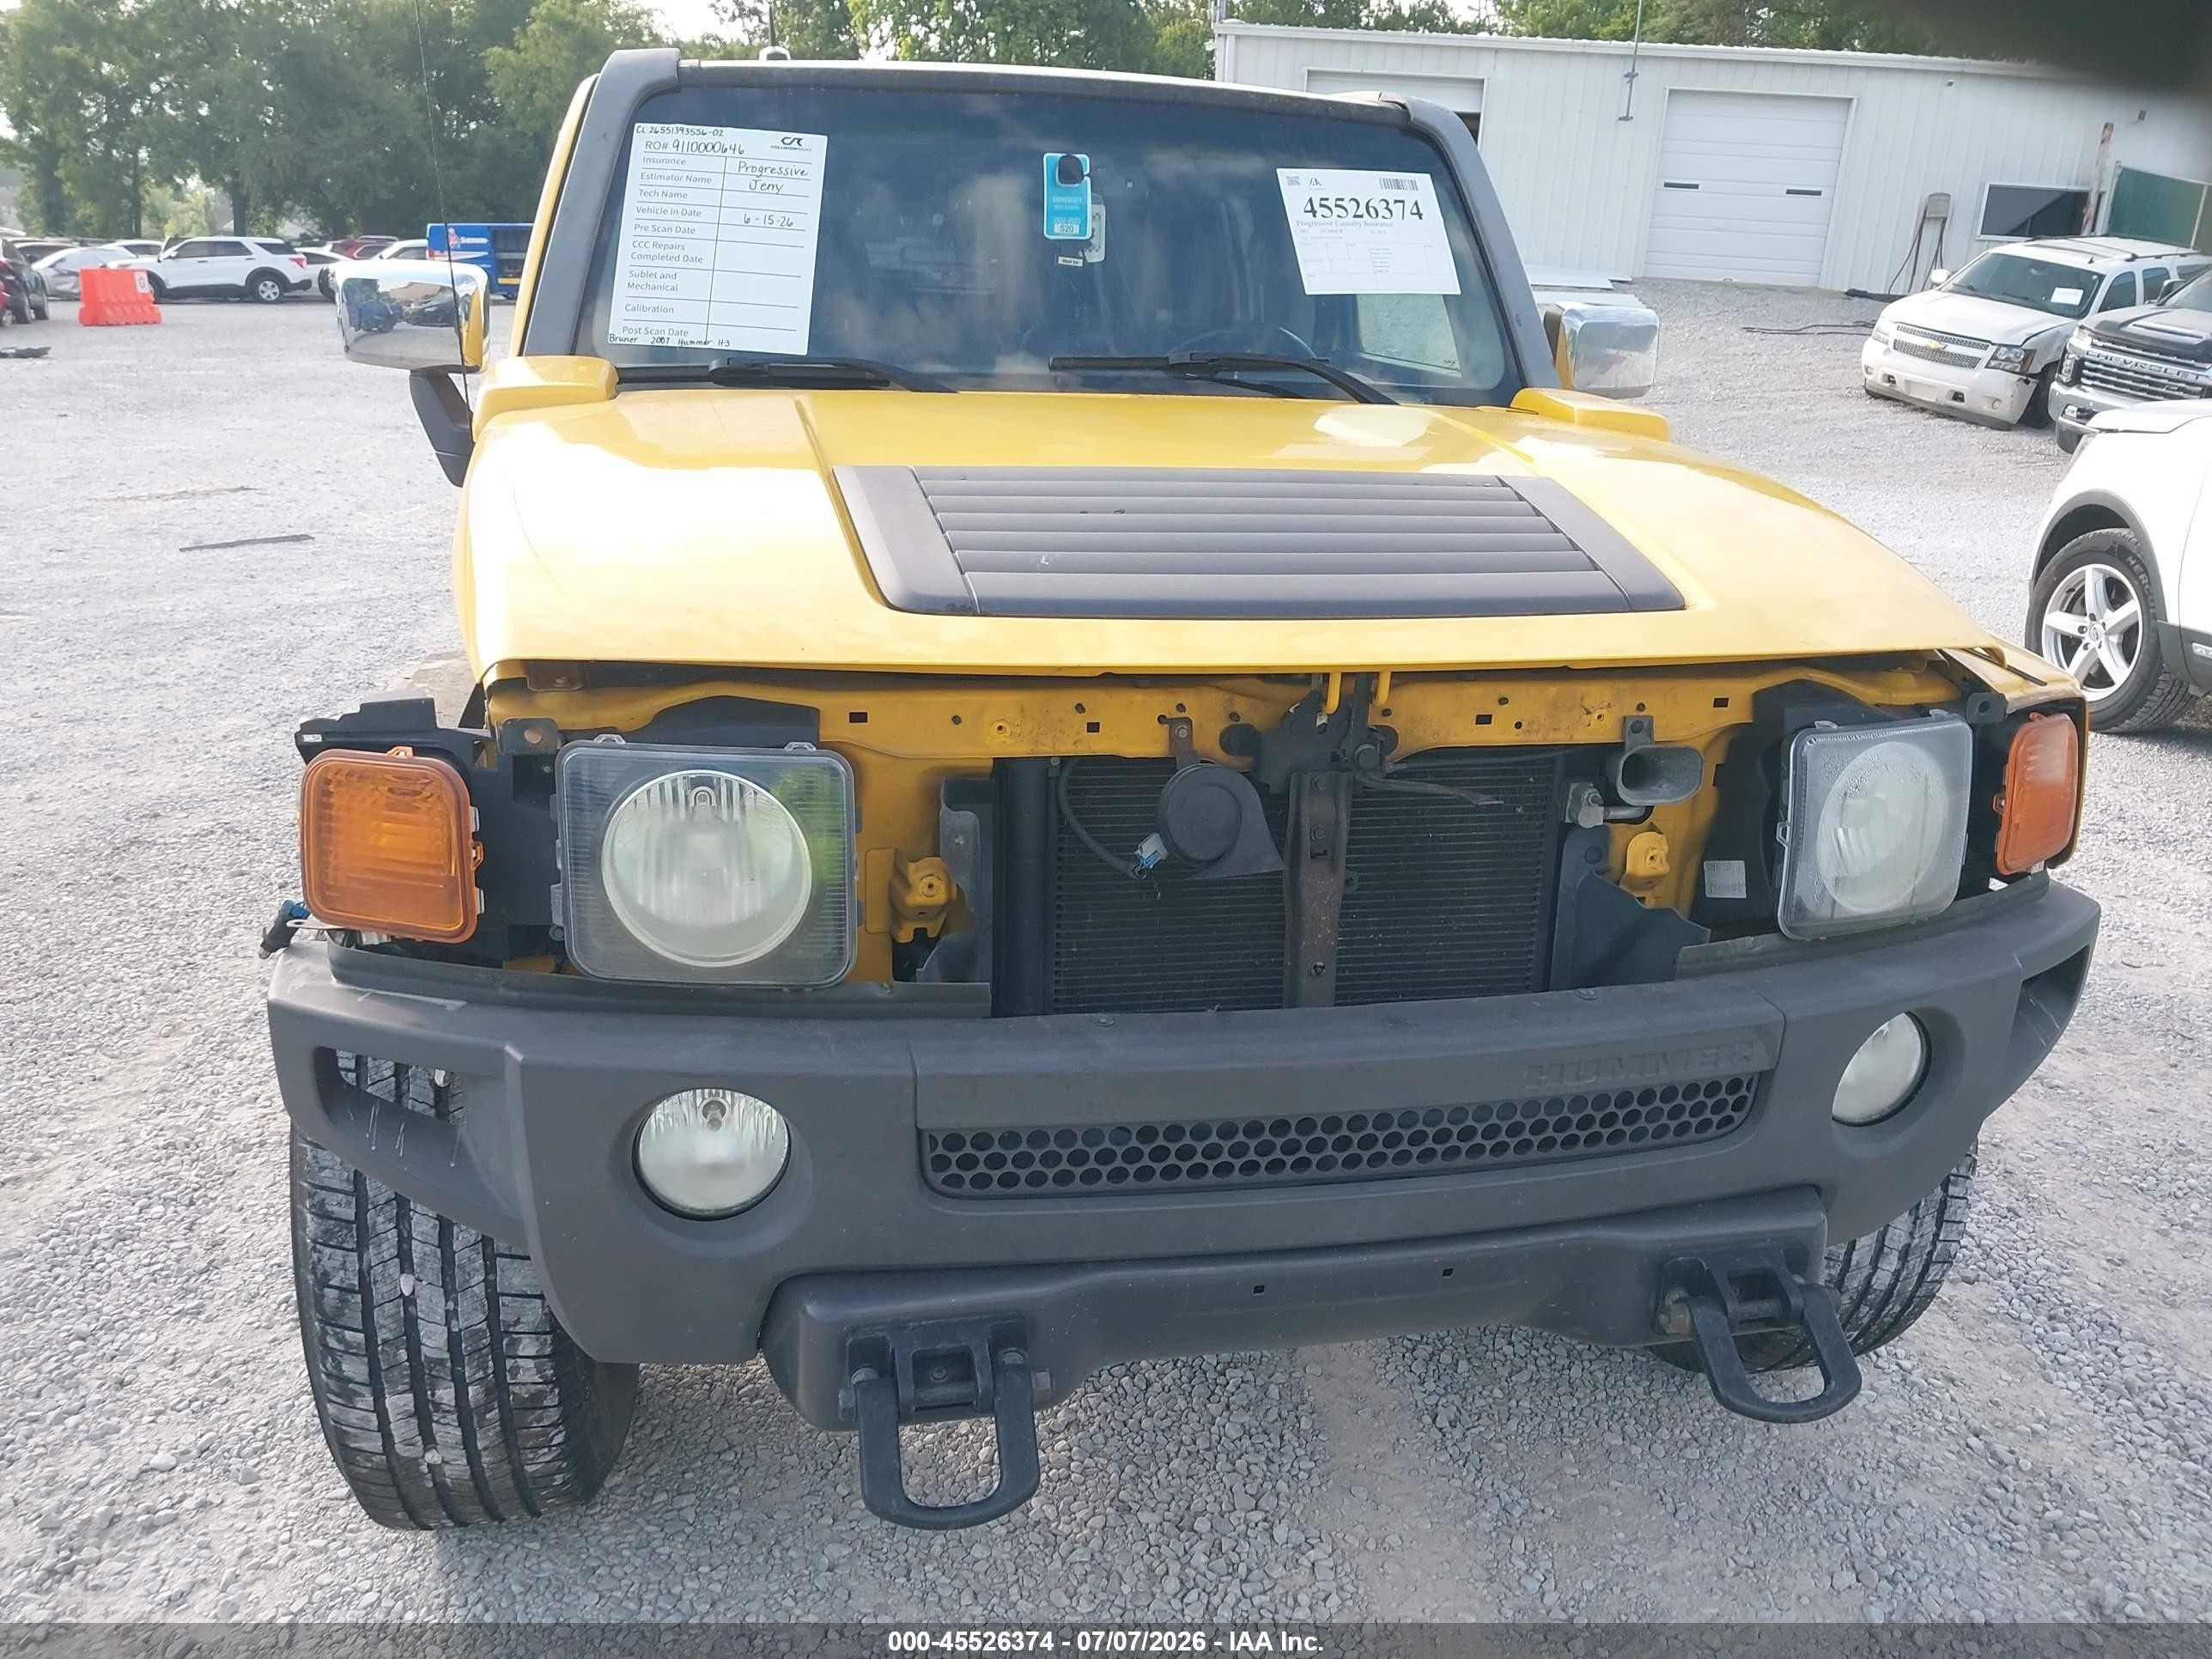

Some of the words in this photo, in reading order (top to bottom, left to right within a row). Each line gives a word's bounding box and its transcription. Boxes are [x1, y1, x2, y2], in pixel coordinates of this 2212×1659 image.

[646, 141, 668, 150] RO#
[642, 155, 687, 165] Insurance
[738, 161, 809, 179] Progressive
[641, 172, 684, 182] Estimator
[685, 175, 713, 184] Name
[639, 189, 659, 198] Tech
[661, 190, 688, 199] Name
[635, 205, 668, 215] Vehicle
[681, 209, 702, 217] Date
[1304, 196, 1424, 221] 45526374
[651, 224, 672, 234] Scan
[675, 226, 696, 234] Date
[652, 241, 686, 251] Repairs
[630, 252, 681, 262] Completed
[683, 255, 704, 264] Date
[629, 270, 657, 279] Sublet
[138, 276, 146, 289] G
[627, 282, 678, 292] Mechanical
[624, 304, 674, 314] Calibration
[622, 325, 641, 335] Post
[644, 327, 665, 336] Scan
[668, 328, 689, 337] Date
[609, 333, 639, 343] Bruner
[651, 336, 670, 344] 2007
